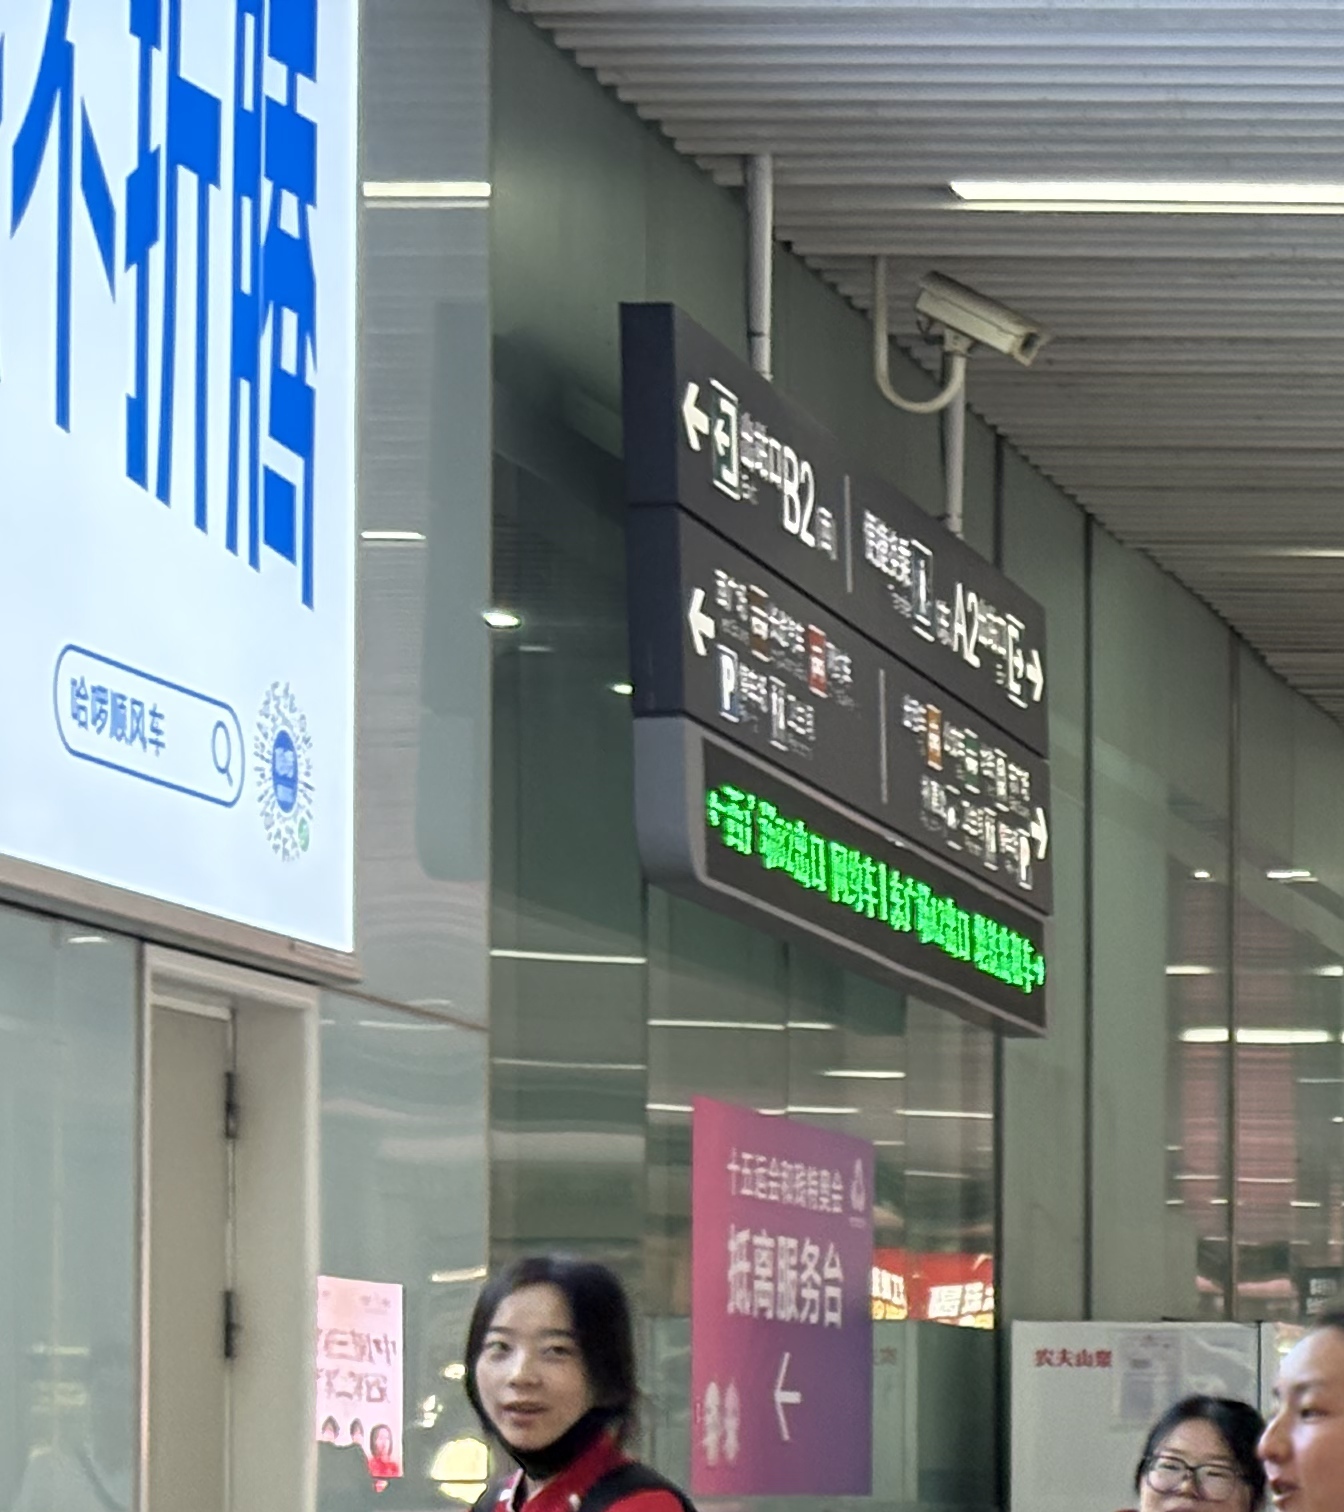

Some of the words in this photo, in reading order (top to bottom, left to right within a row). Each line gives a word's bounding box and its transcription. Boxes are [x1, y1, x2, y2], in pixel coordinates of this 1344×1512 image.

[69, 676, 167, 758] 哈啰顺风车
[727, 1147, 844, 1213] 十五运会和残特奥会
[727, 1223, 844, 1330] 抵离服务台
